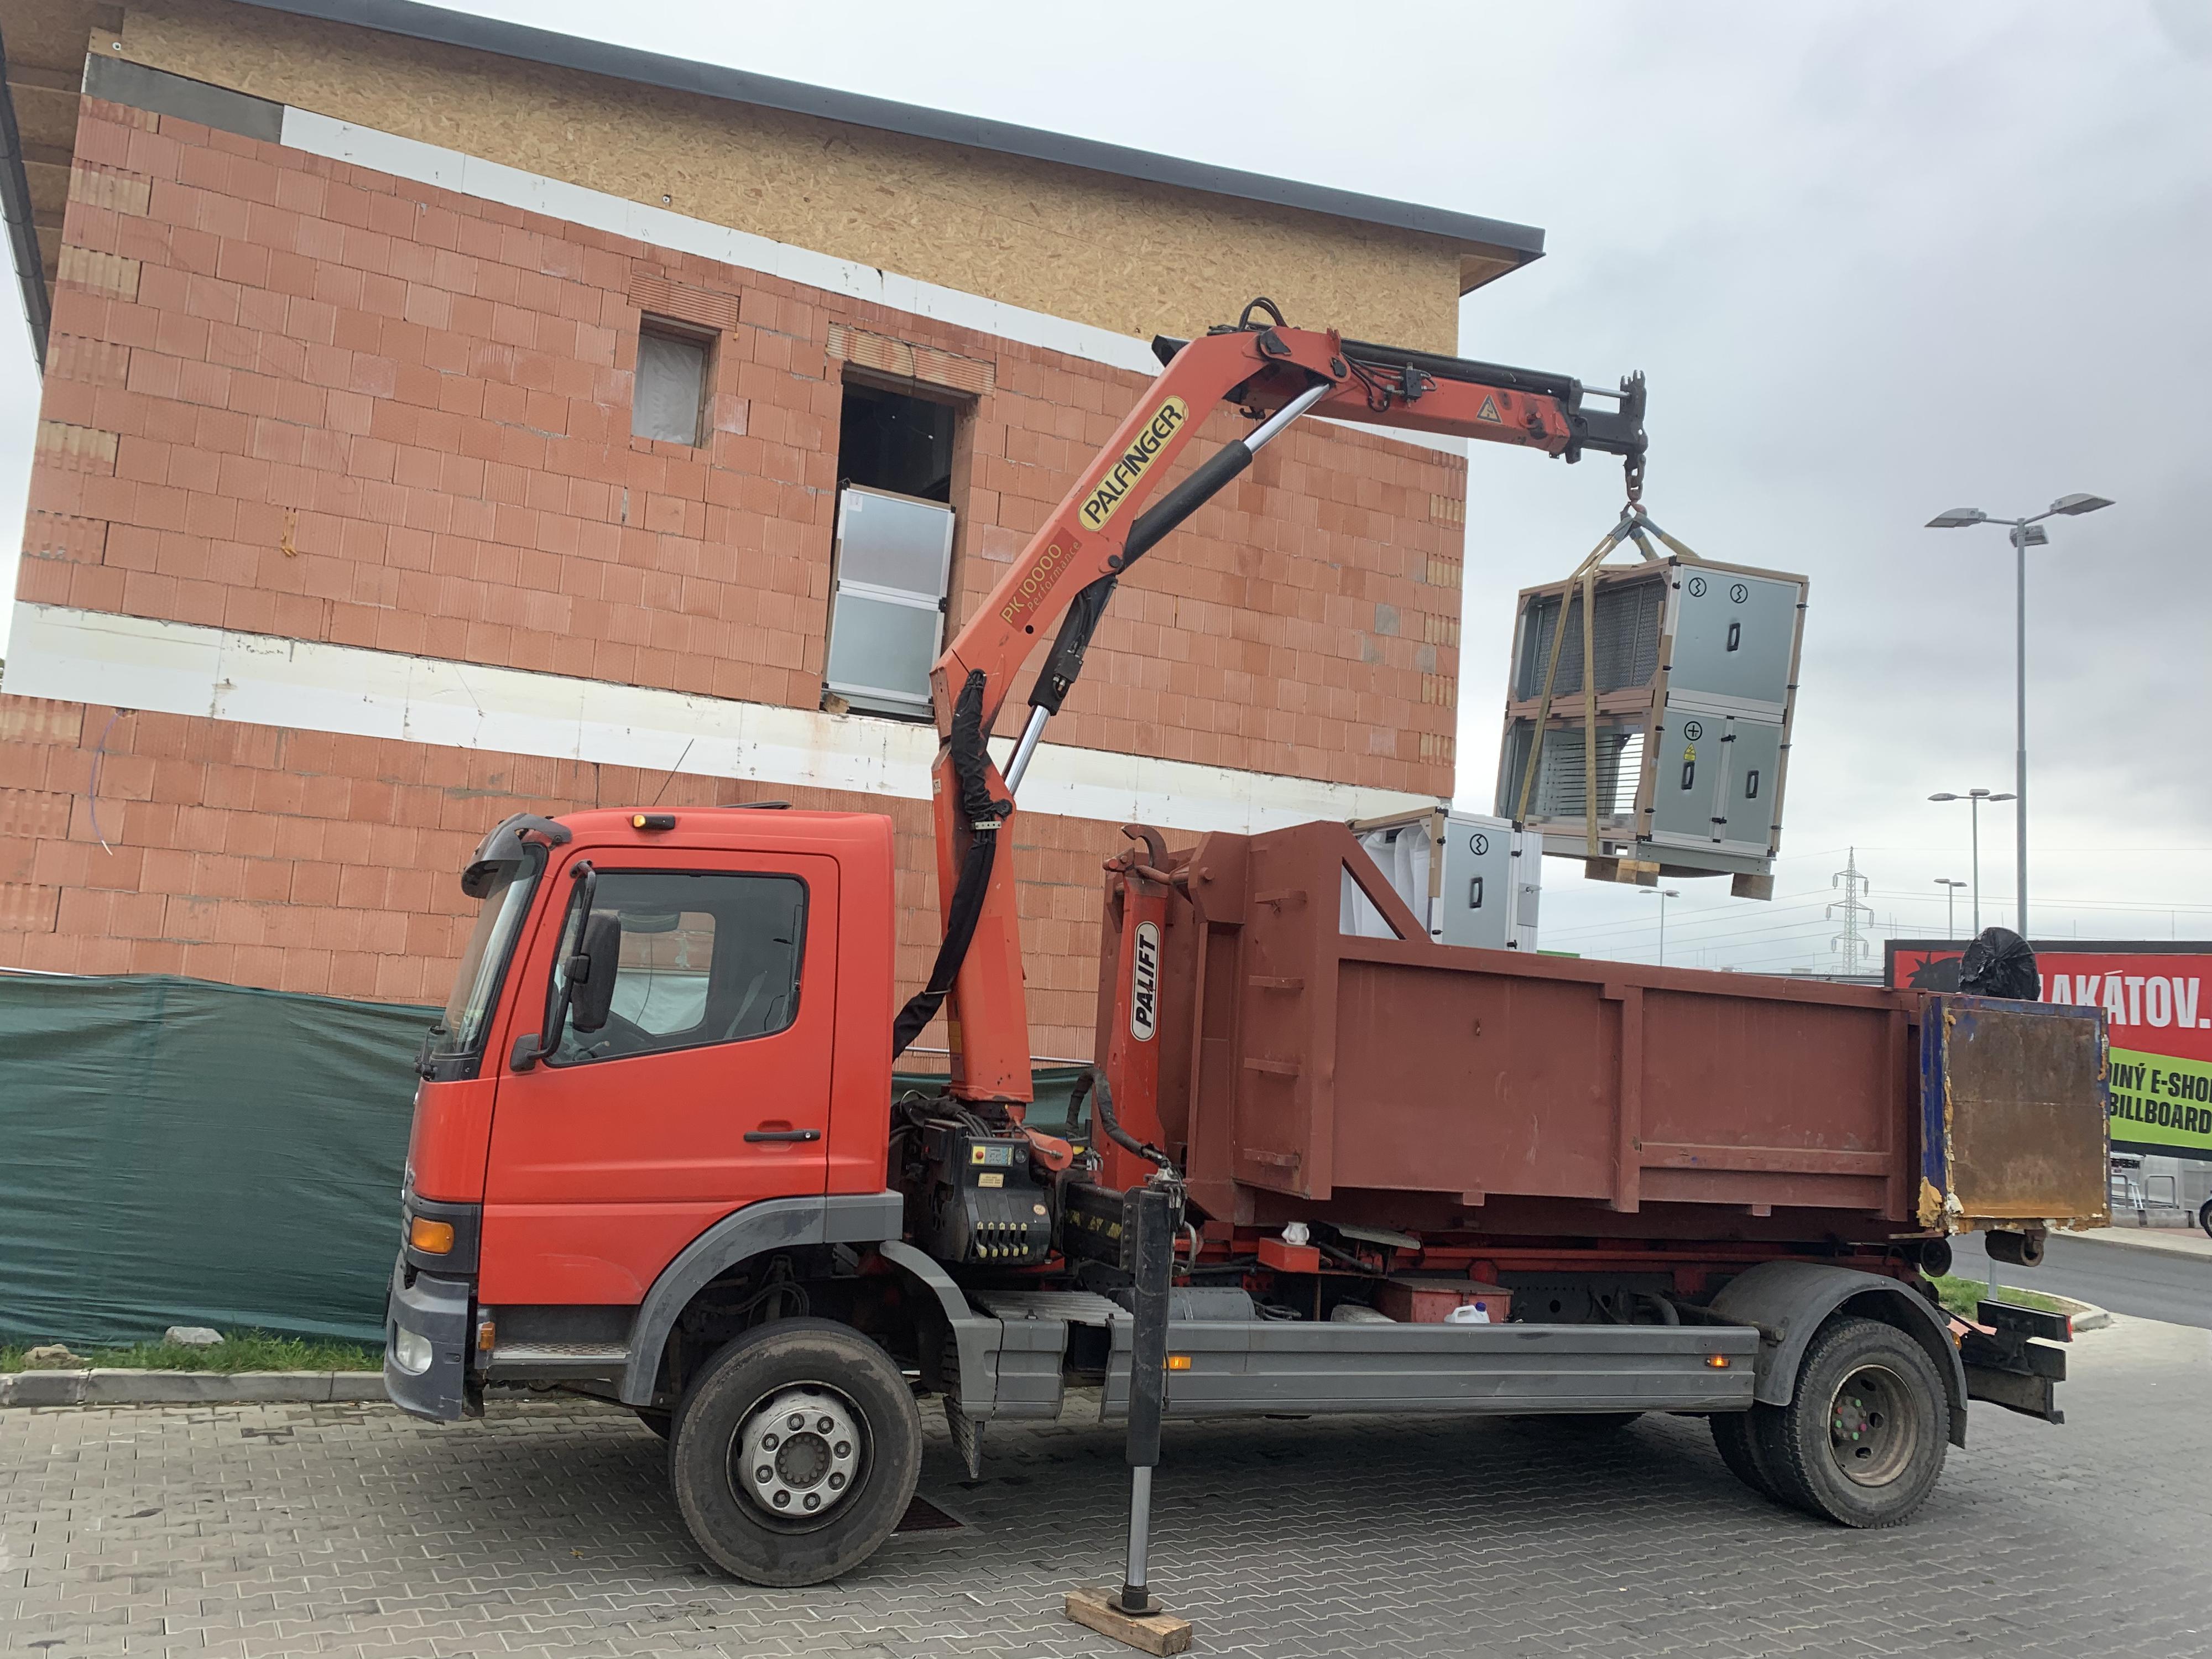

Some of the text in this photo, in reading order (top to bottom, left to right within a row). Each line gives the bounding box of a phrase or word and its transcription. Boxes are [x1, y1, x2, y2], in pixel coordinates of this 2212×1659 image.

[1083, 404, 1182, 524] PALFINGER
[1001, 544, 1062, 624] PK 10000
[1027, 541, 1079, 612] Performance
[1135, 933, 1156, 1029] PALIFT
[2110, 1092, 2211, 1134] BILLBOARD
